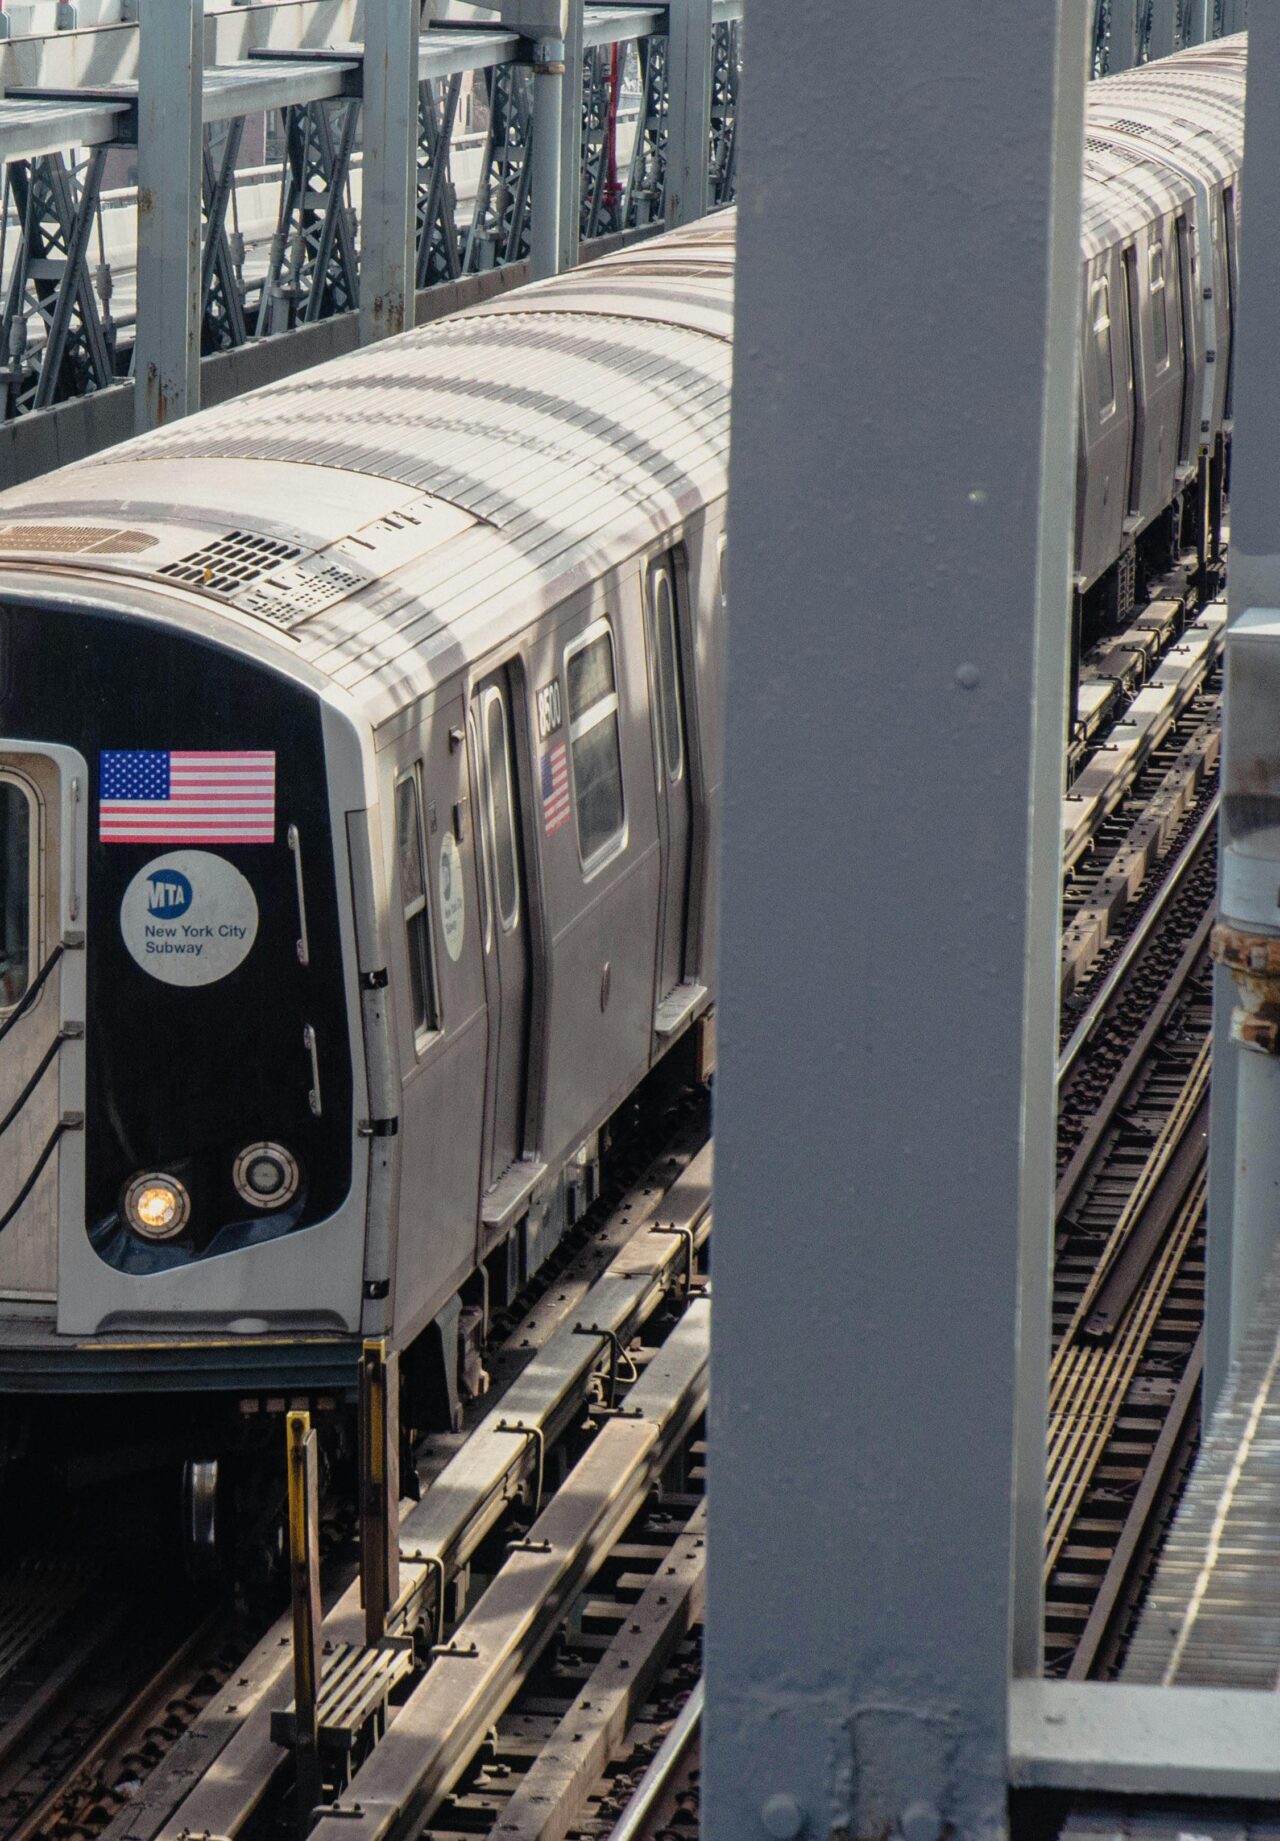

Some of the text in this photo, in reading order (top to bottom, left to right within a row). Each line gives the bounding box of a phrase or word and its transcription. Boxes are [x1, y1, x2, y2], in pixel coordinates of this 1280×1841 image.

[146, 879, 185, 909] MTA
[145, 925, 246, 939] New York City
[145, 941, 203, 956] Subway
